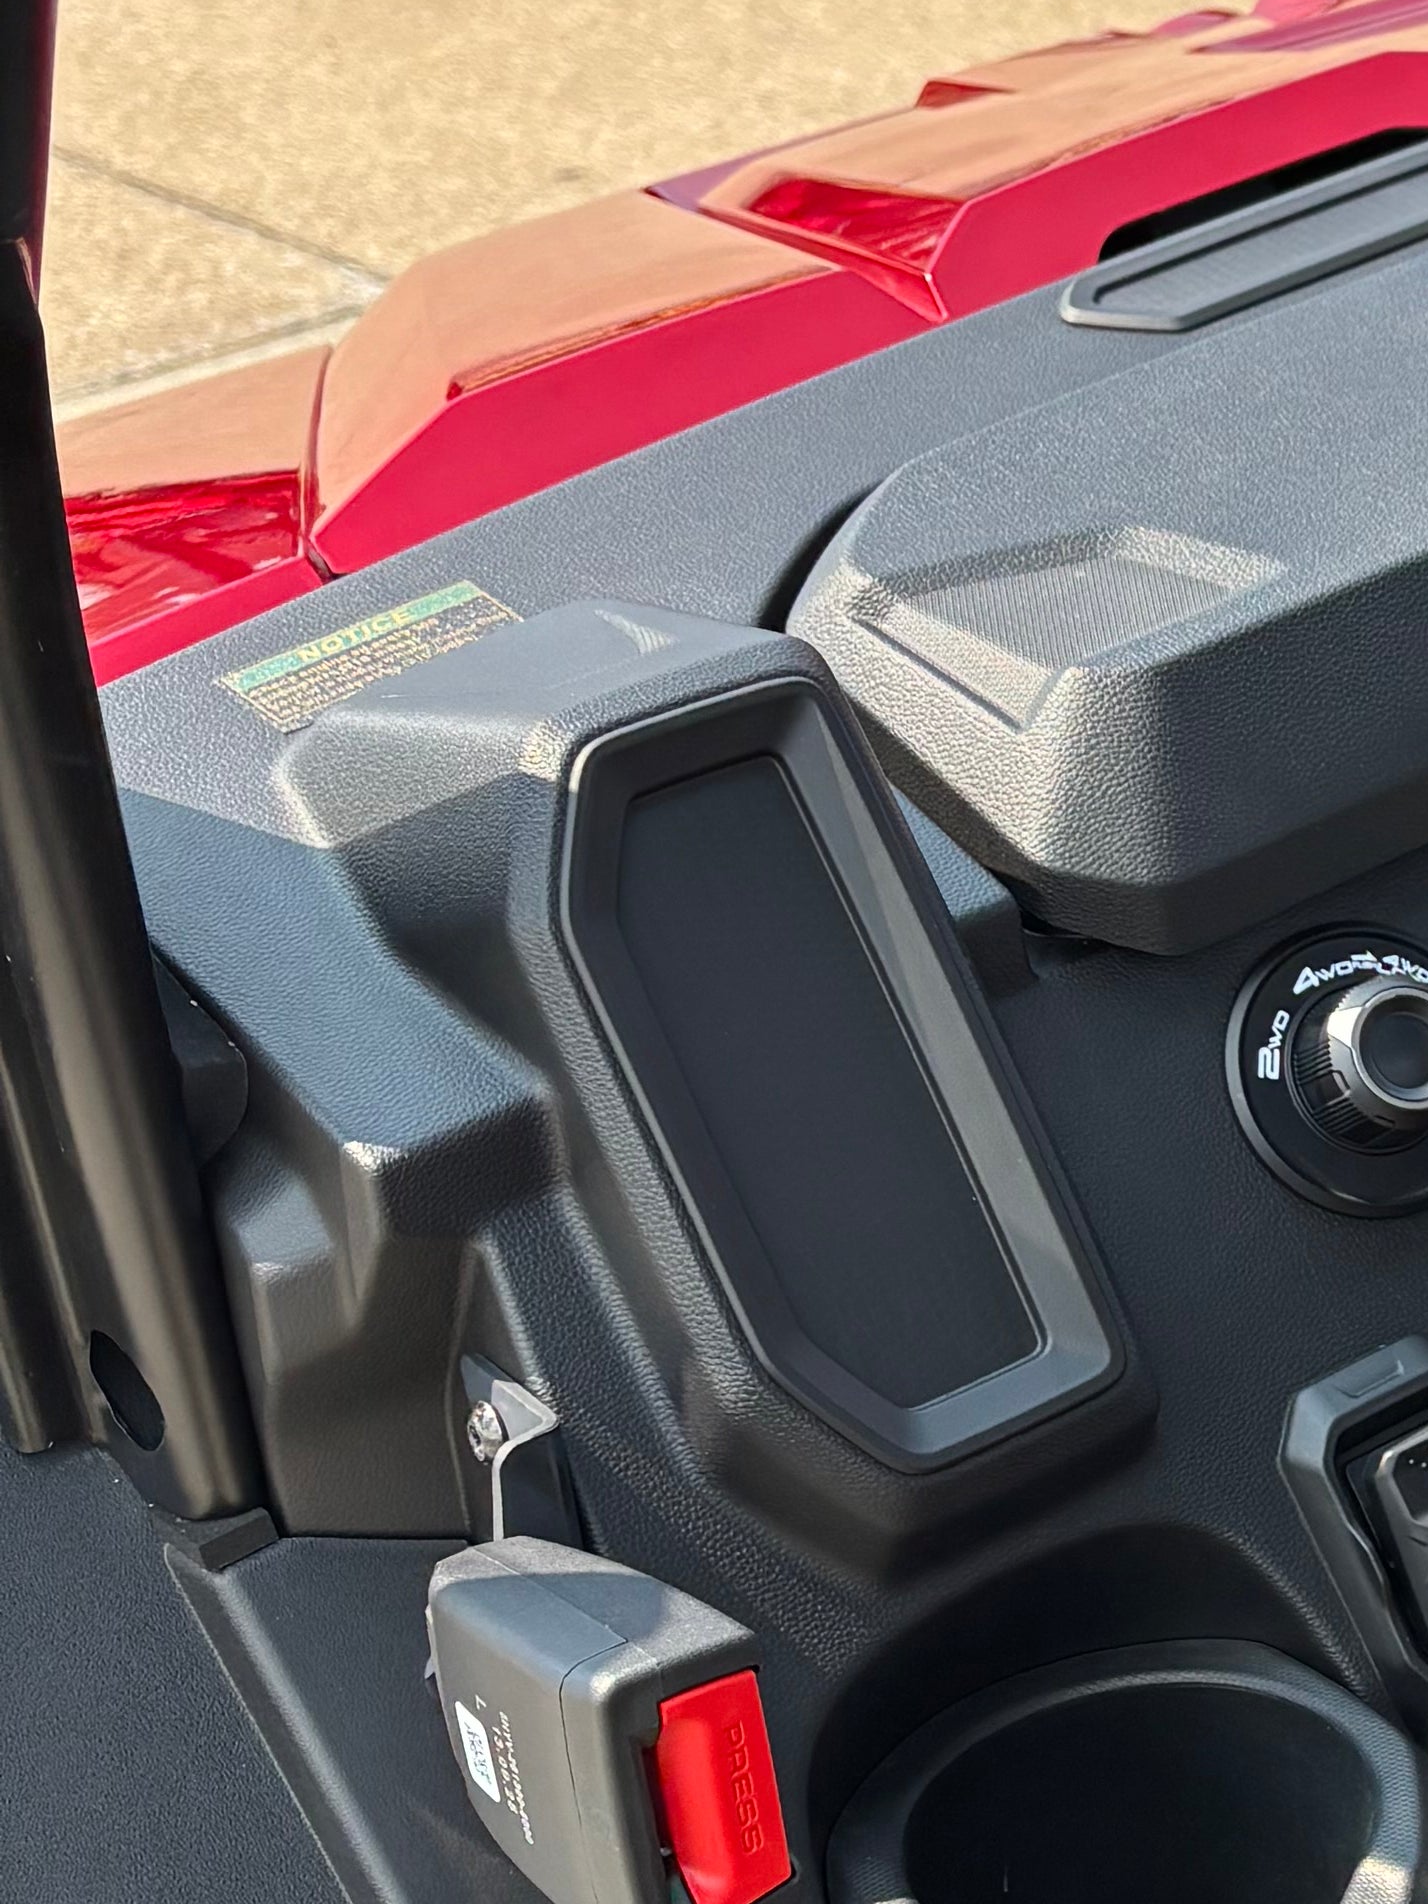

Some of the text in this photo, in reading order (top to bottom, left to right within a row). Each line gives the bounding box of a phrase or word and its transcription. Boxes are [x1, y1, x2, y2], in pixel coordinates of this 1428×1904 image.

[300, 610, 412, 662] NOTICE
[1293, 960, 1354, 995] 4WD
[1258, 1010, 1290, 1080] 2WD
[724, 1719, 764, 1856] PRESS
